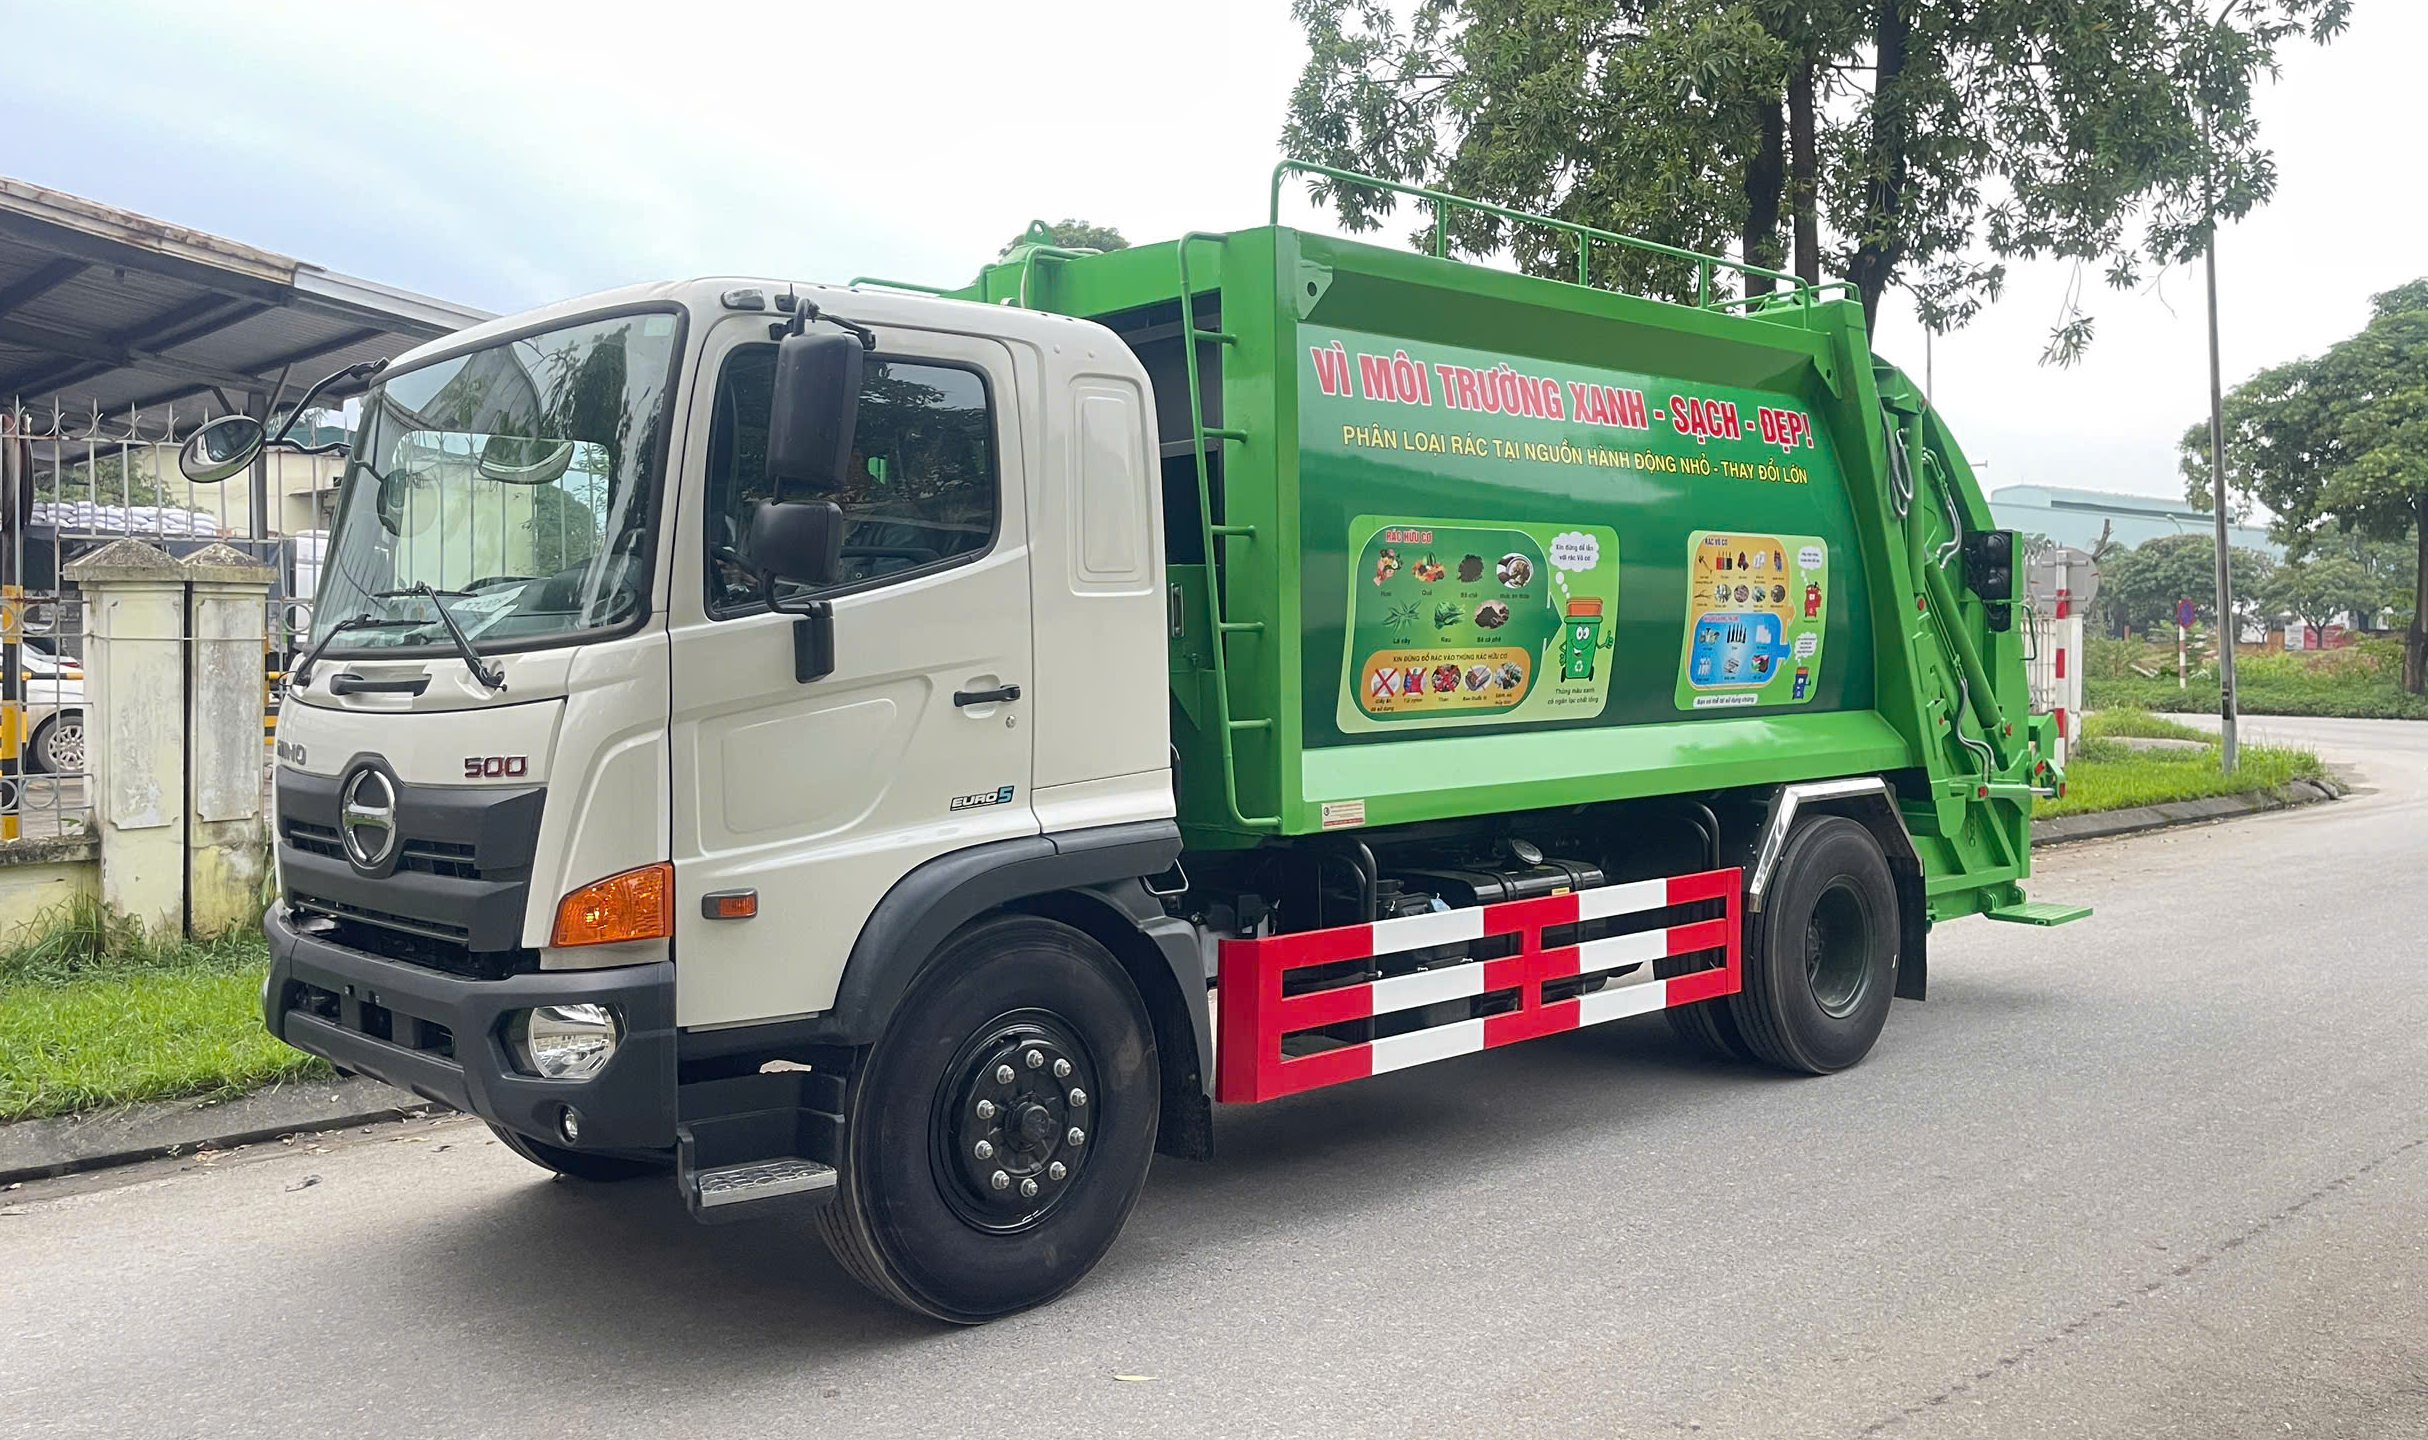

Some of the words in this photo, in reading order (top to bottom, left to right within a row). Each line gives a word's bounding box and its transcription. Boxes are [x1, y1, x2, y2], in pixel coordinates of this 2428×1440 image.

[1310, 340, 1352, 397] VÌ
[1358, 350, 1432, 406] MÔI
[1435, 363, 1565, 420] TRƯỜNG
[1567, 382, 1648, 430] XANH
[1670, 394, 1741, 444] SẠCH
[1758, 406, 1814, 454] ĐẸP!
[1342, 422, 1397, 448] PHÂN
[1403, 431, 1446, 456] LOẠI
[1451, 433, 1488, 457] RÁC
[1492, 440, 1520, 463] TẠI
[1525, 438, 1583, 464] NGUỒN
[1587, 445, 1630, 469] HÀNH
[1635, 450, 1676, 473] ĐỘNG
[1680, 453, 1710, 476] NHỎ
[1721, 460, 1754, 480] THAY
[1758, 457, 1781, 482] ĐỔI
[1783, 464, 1808, 484] LỚN
[1386, 529, 1402, 543] RÁC
[464, 755, 529, 778] 500
